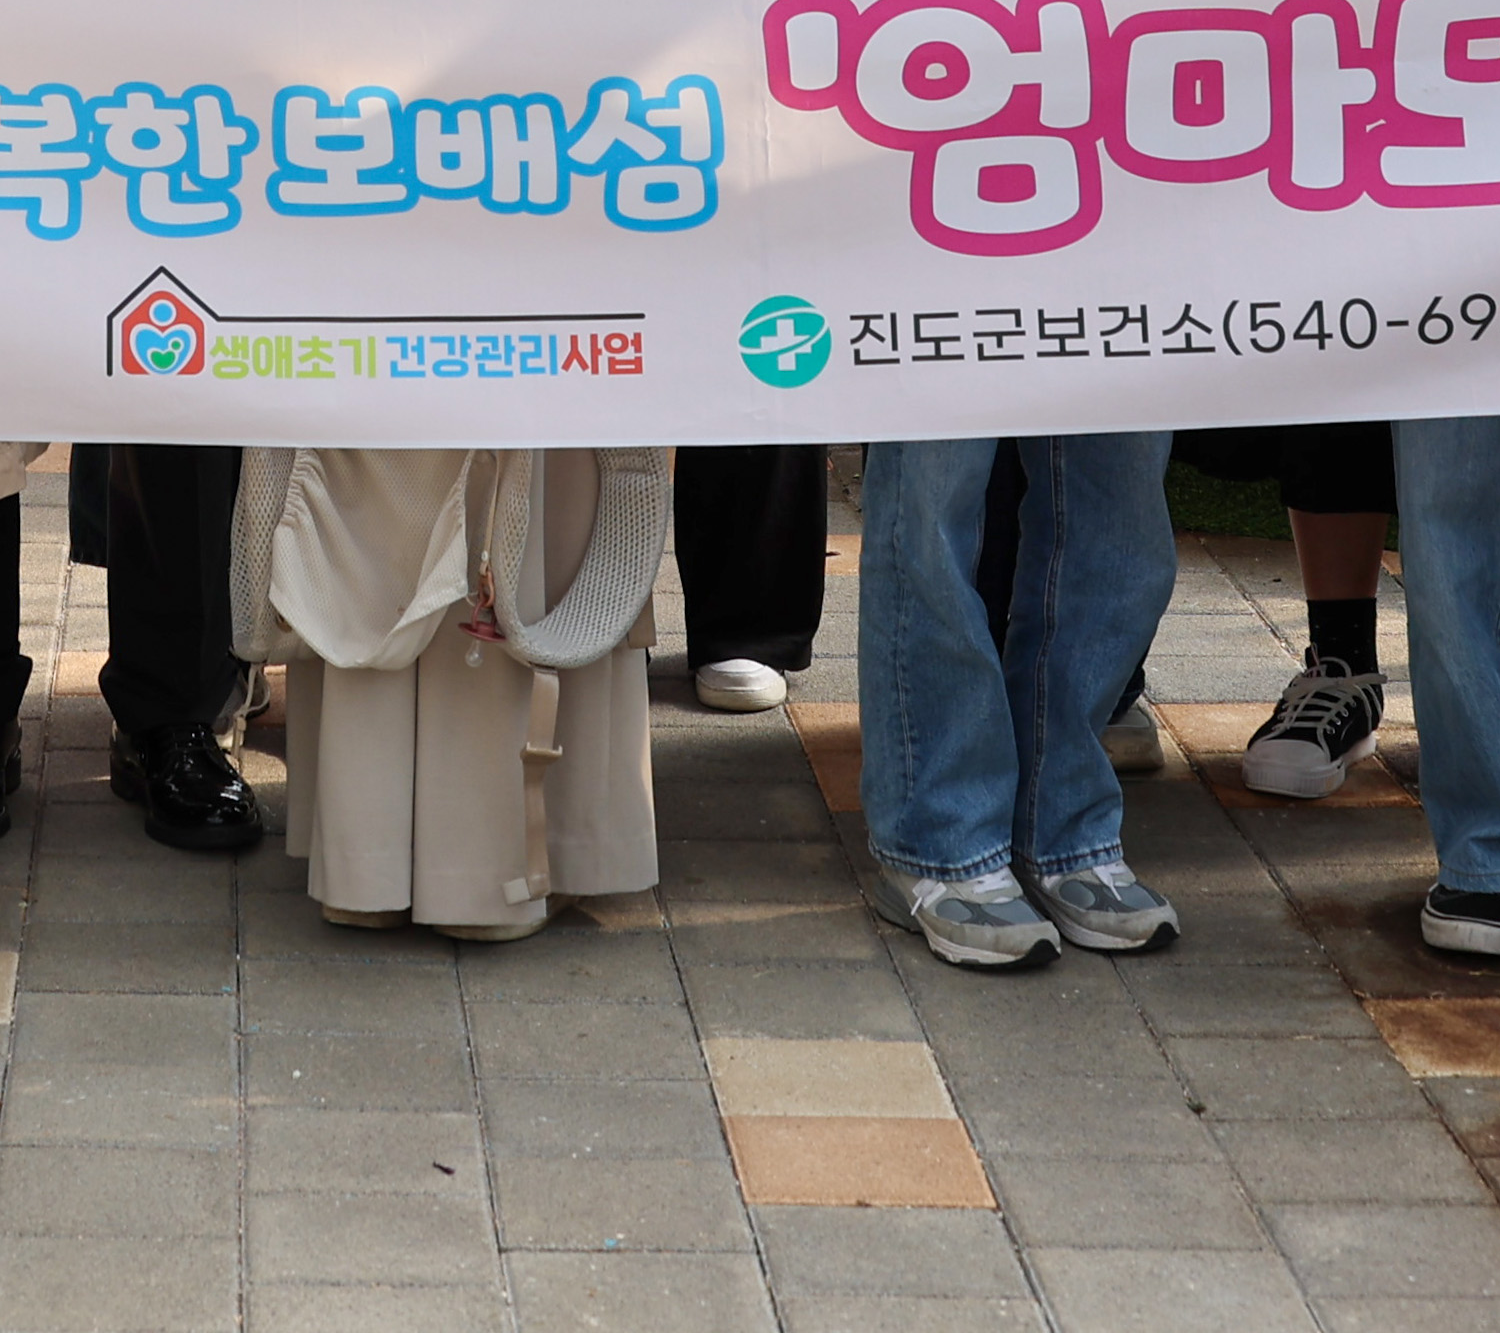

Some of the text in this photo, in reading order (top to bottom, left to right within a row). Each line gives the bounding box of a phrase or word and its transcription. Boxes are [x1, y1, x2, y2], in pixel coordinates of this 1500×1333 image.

[264, 75, 724, 232] 보배섬
[210, 332, 643, 380] 생애초기 건강관리사업
